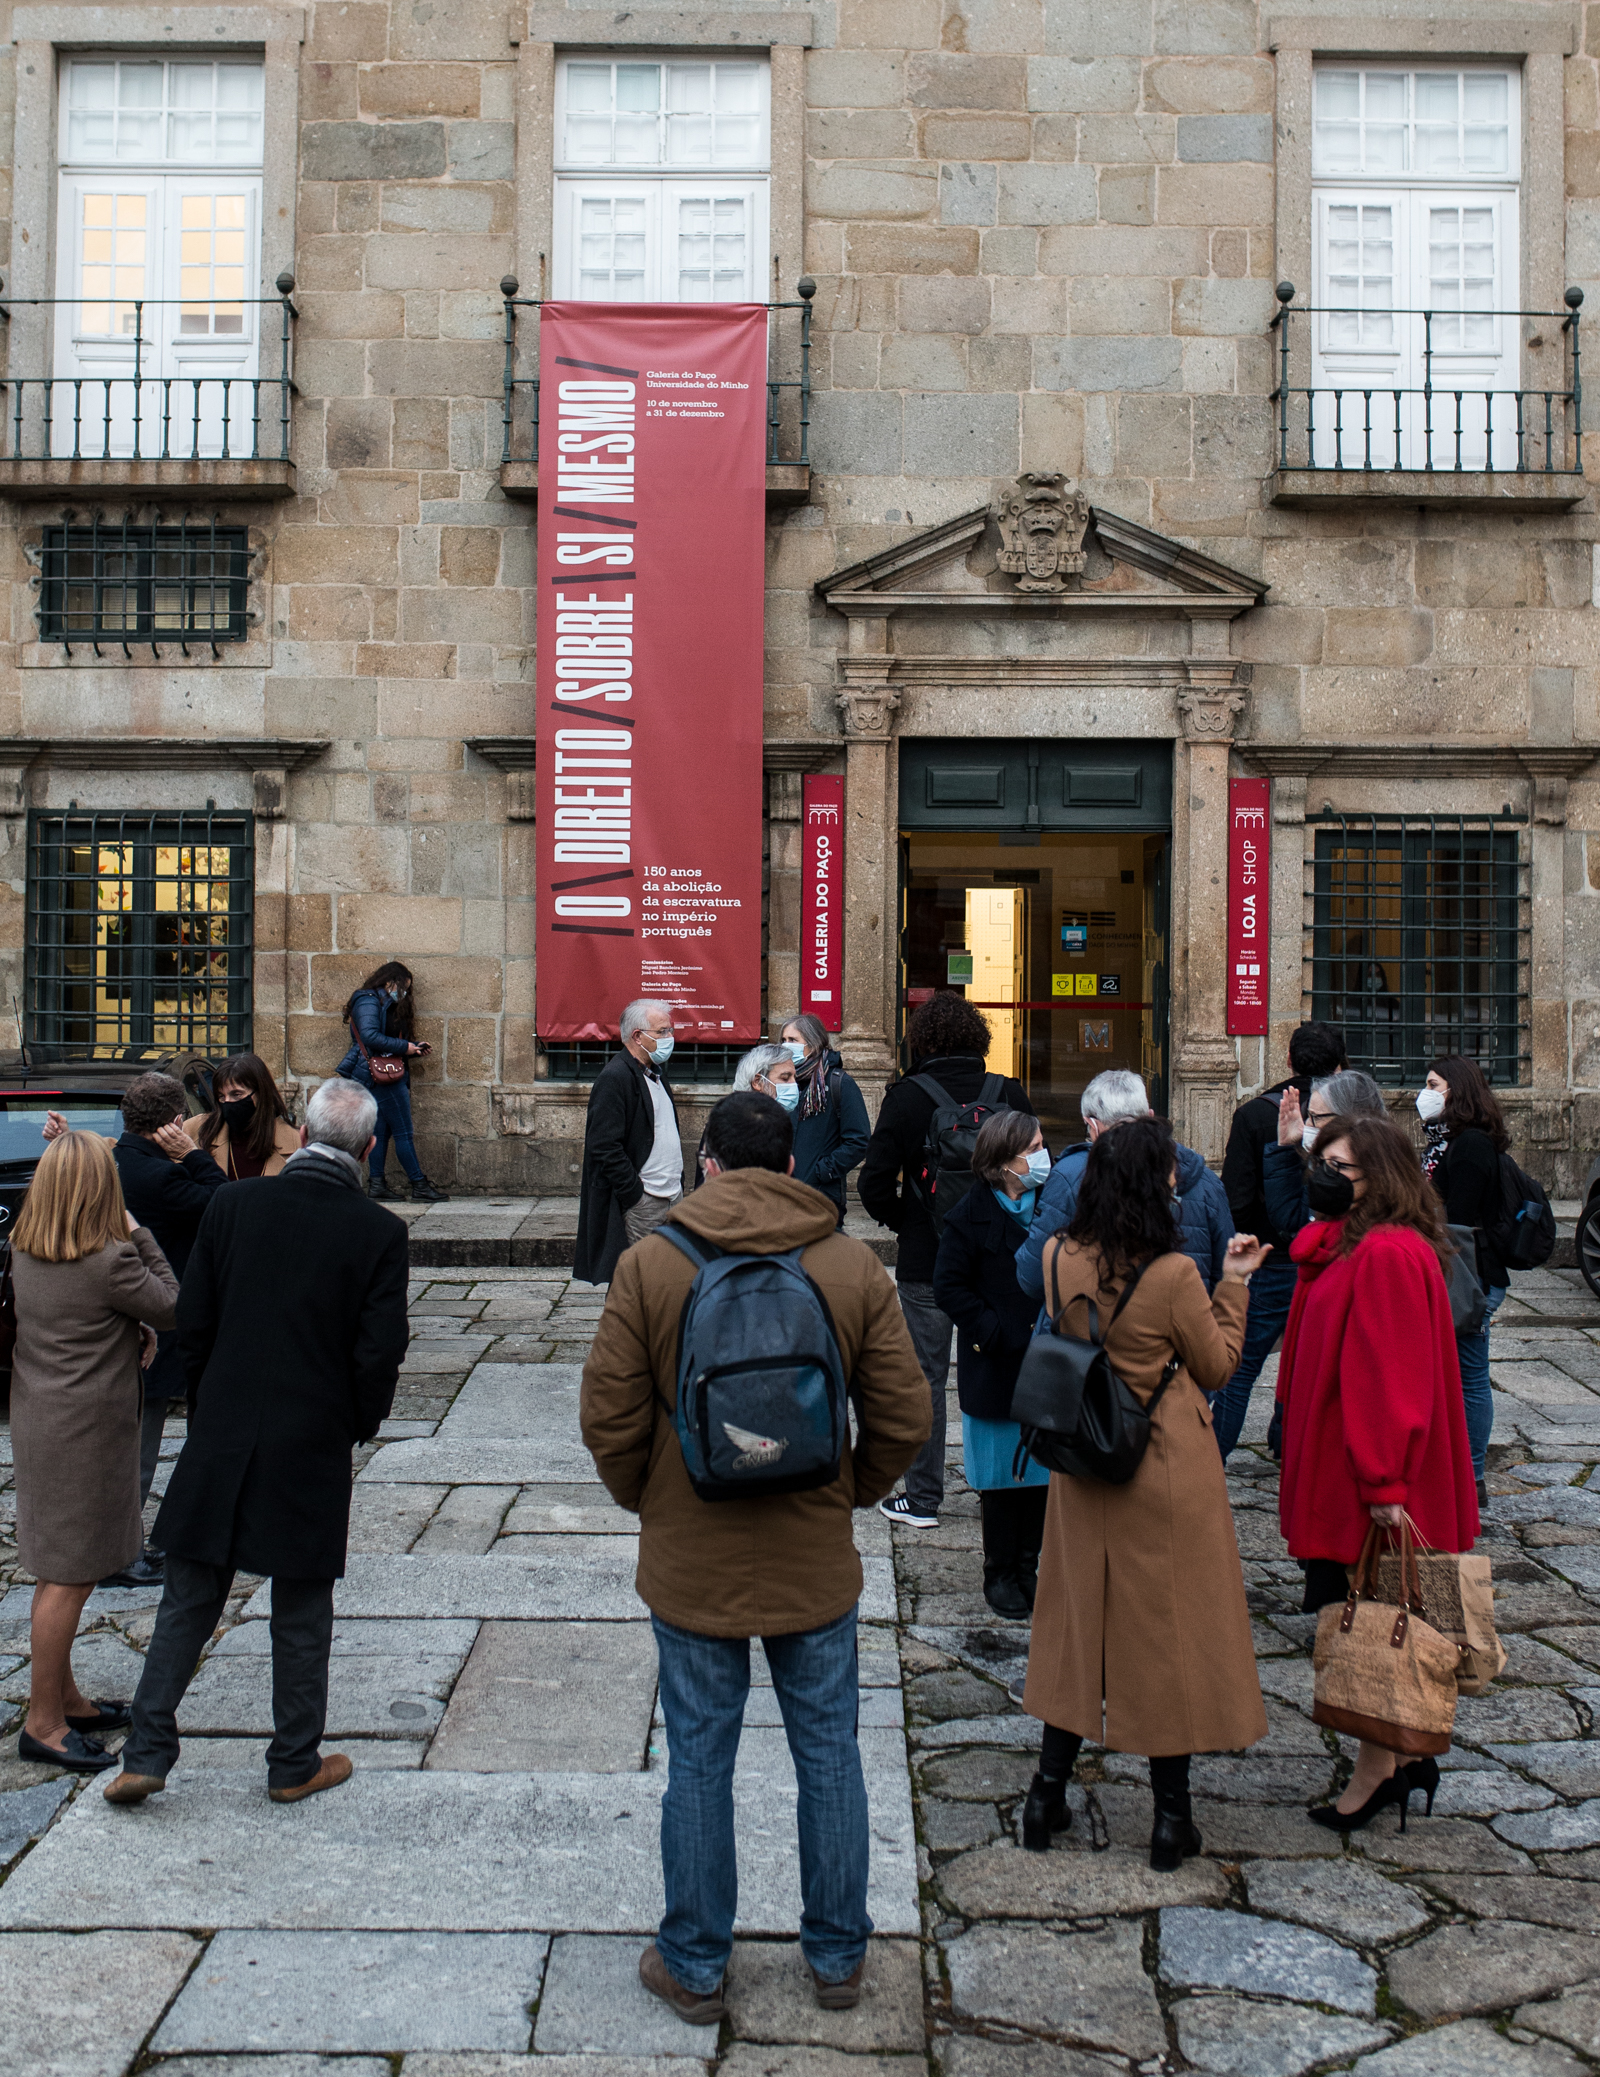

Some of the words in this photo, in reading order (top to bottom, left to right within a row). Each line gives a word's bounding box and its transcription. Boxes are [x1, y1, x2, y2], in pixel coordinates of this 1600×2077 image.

[646, 371, 679, 379] Galeria
[682, 371, 693, 379] do
[695, 372, 716, 380] Paço
[557, 381, 636, 503] MESMO
[556, 533, 634, 565] SI
[555, 593, 633, 701] SOBRE
[554, 729, 632, 863] DIREITO
[816, 835, 832, 878] PAÇO
[1243, 840, 1256, 884] SHOP
[644, 866, 666, 876] 150
[670, 869, 702, 877] anos
[642, 881, 660, 891] da
[663, 882, 722, 894] abolição
[642, 896, 660, 906] da
[663, 898, 741, 907] escravatura
[816, 883, 828, 907] DO
[555, 896, 631, 916] O
[642, 913, 659, 921] no
[663, 911, 717, 923] império
[1242, 894, 1256, 938] LOJA
[642, 926, 712, 938] português
[815, 912, 828, 980] GALERIA
